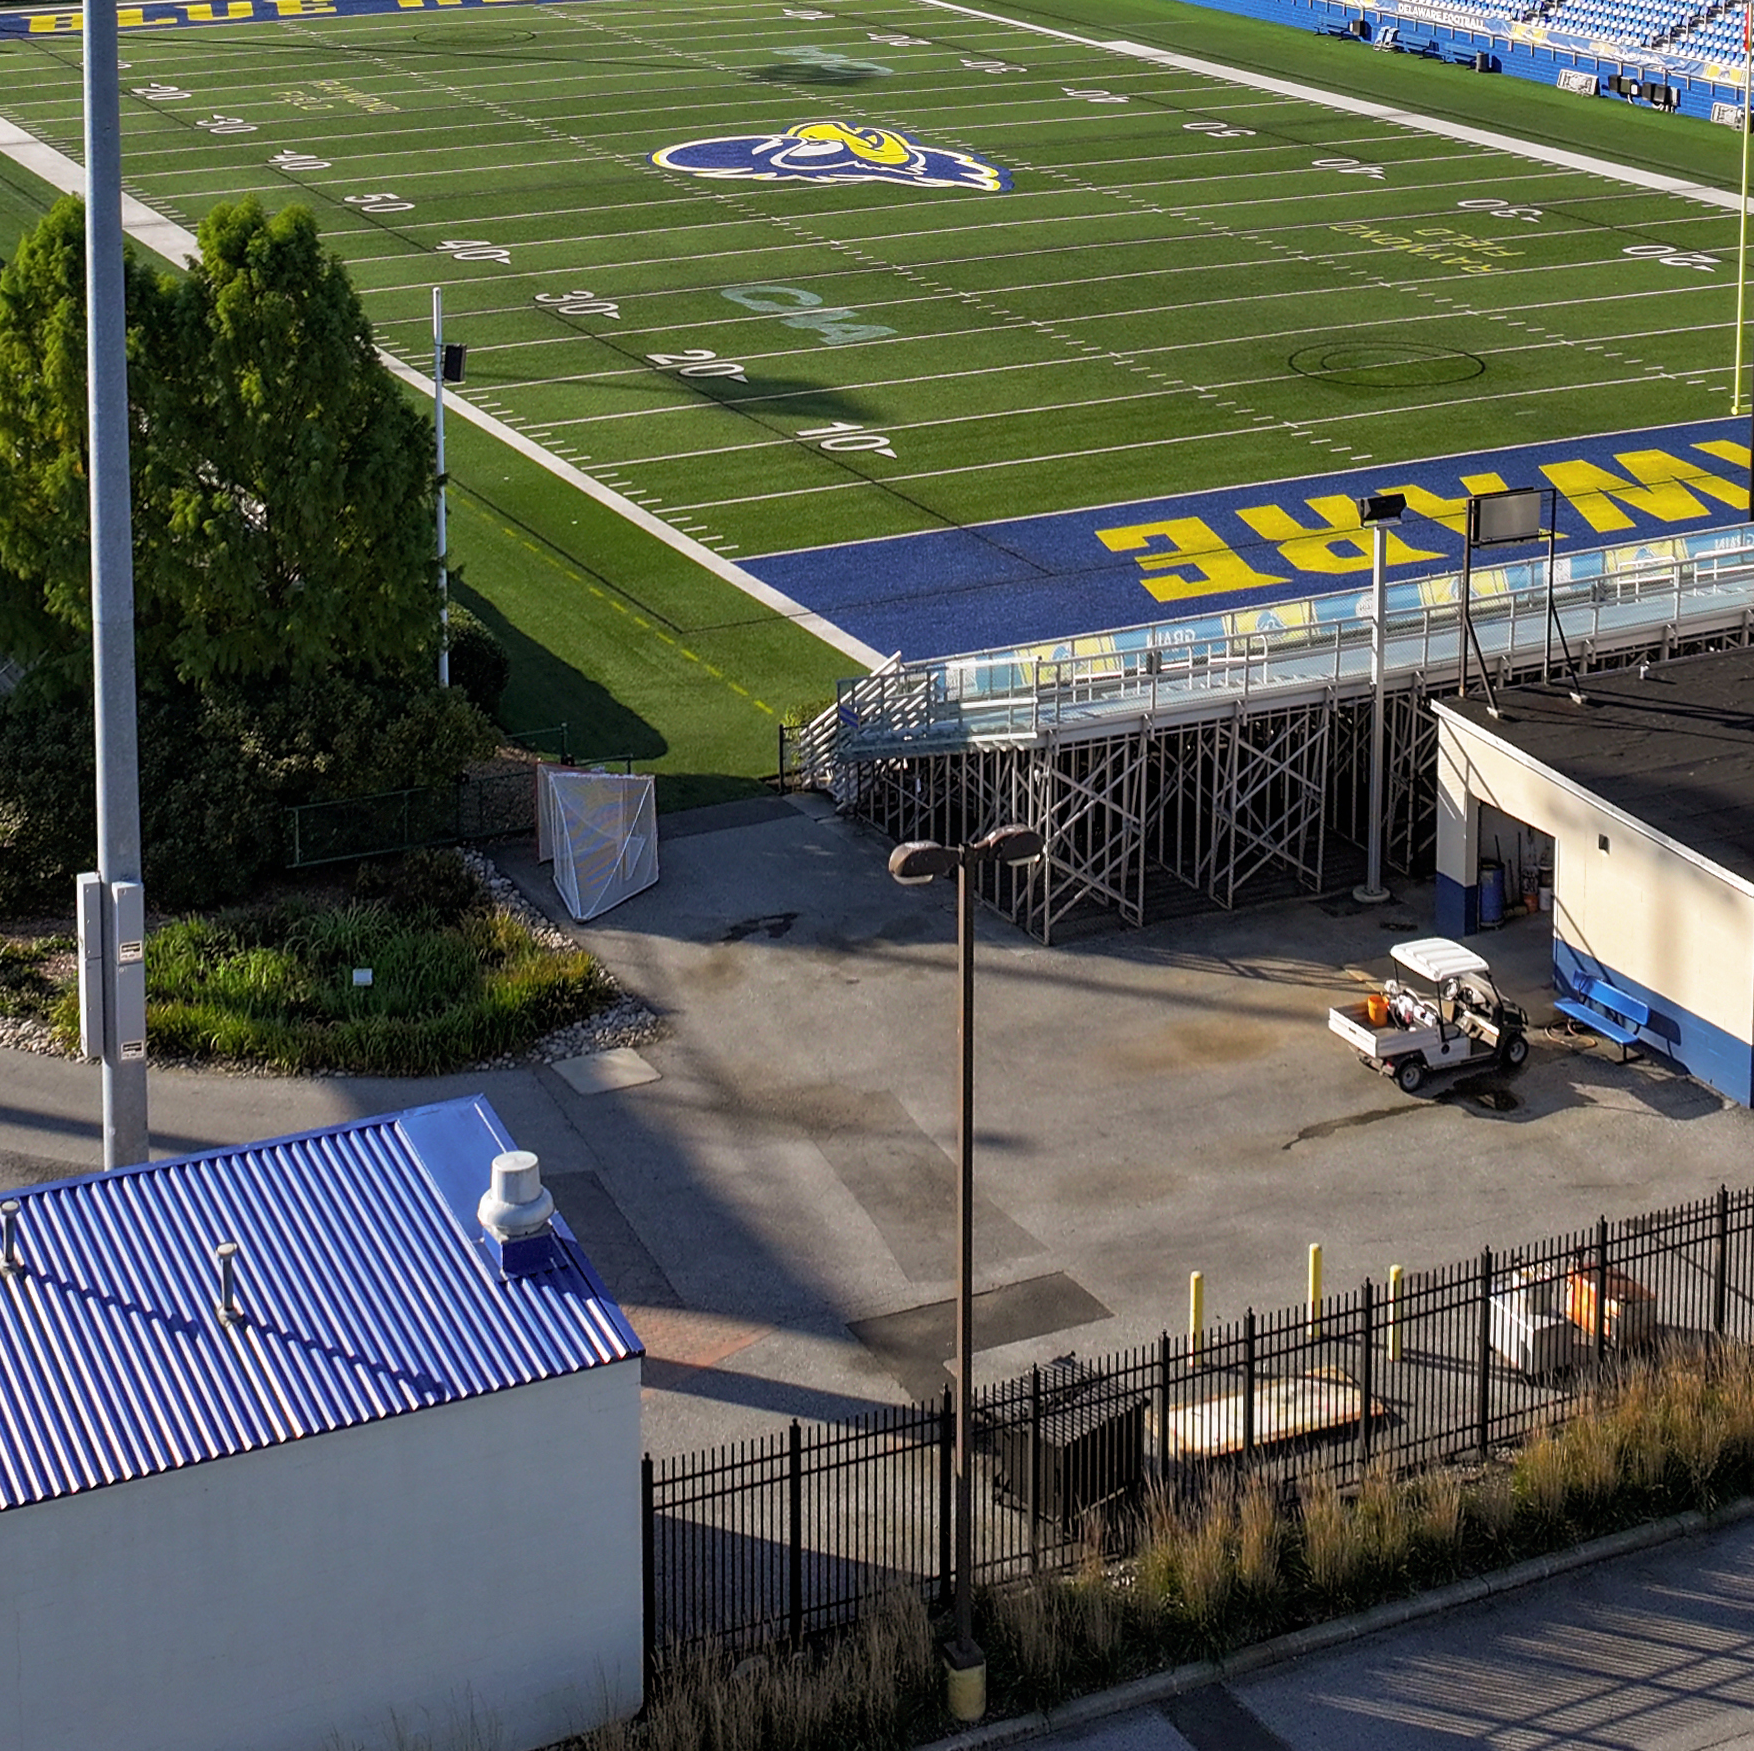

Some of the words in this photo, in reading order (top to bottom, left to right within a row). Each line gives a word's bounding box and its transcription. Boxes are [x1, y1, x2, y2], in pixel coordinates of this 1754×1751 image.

[1398, 2, 1442, 22] DELAWARE
[1443, 12, 1486, 29] FOOTBALL
[875, 34, 932, 47] 20
[968, 59, 1028, 74] 30
[131, 86, 193, 102] 20
[1068, 90, 1130, 104] 40
[197, 116, 259, 135] 30
[1182, 121, 1256, 138] 50
[267, 154, 332, 172] 40
[1311, 157, 1383, 175] 40
[344, 192, 416, 214] 50
[1456, 198, 1543, 218] 30
[435, 239, 511, 262] 40
[1329, 224, 1504, 273] RAYMOND
[1414, 228, 1526, 257] FIELD
[1623, 244, 1722, 267] 20
[534, 290, 620, 317] 30
[646, 350, 746, 379] 20
[795, 421, 892, 452] 10
